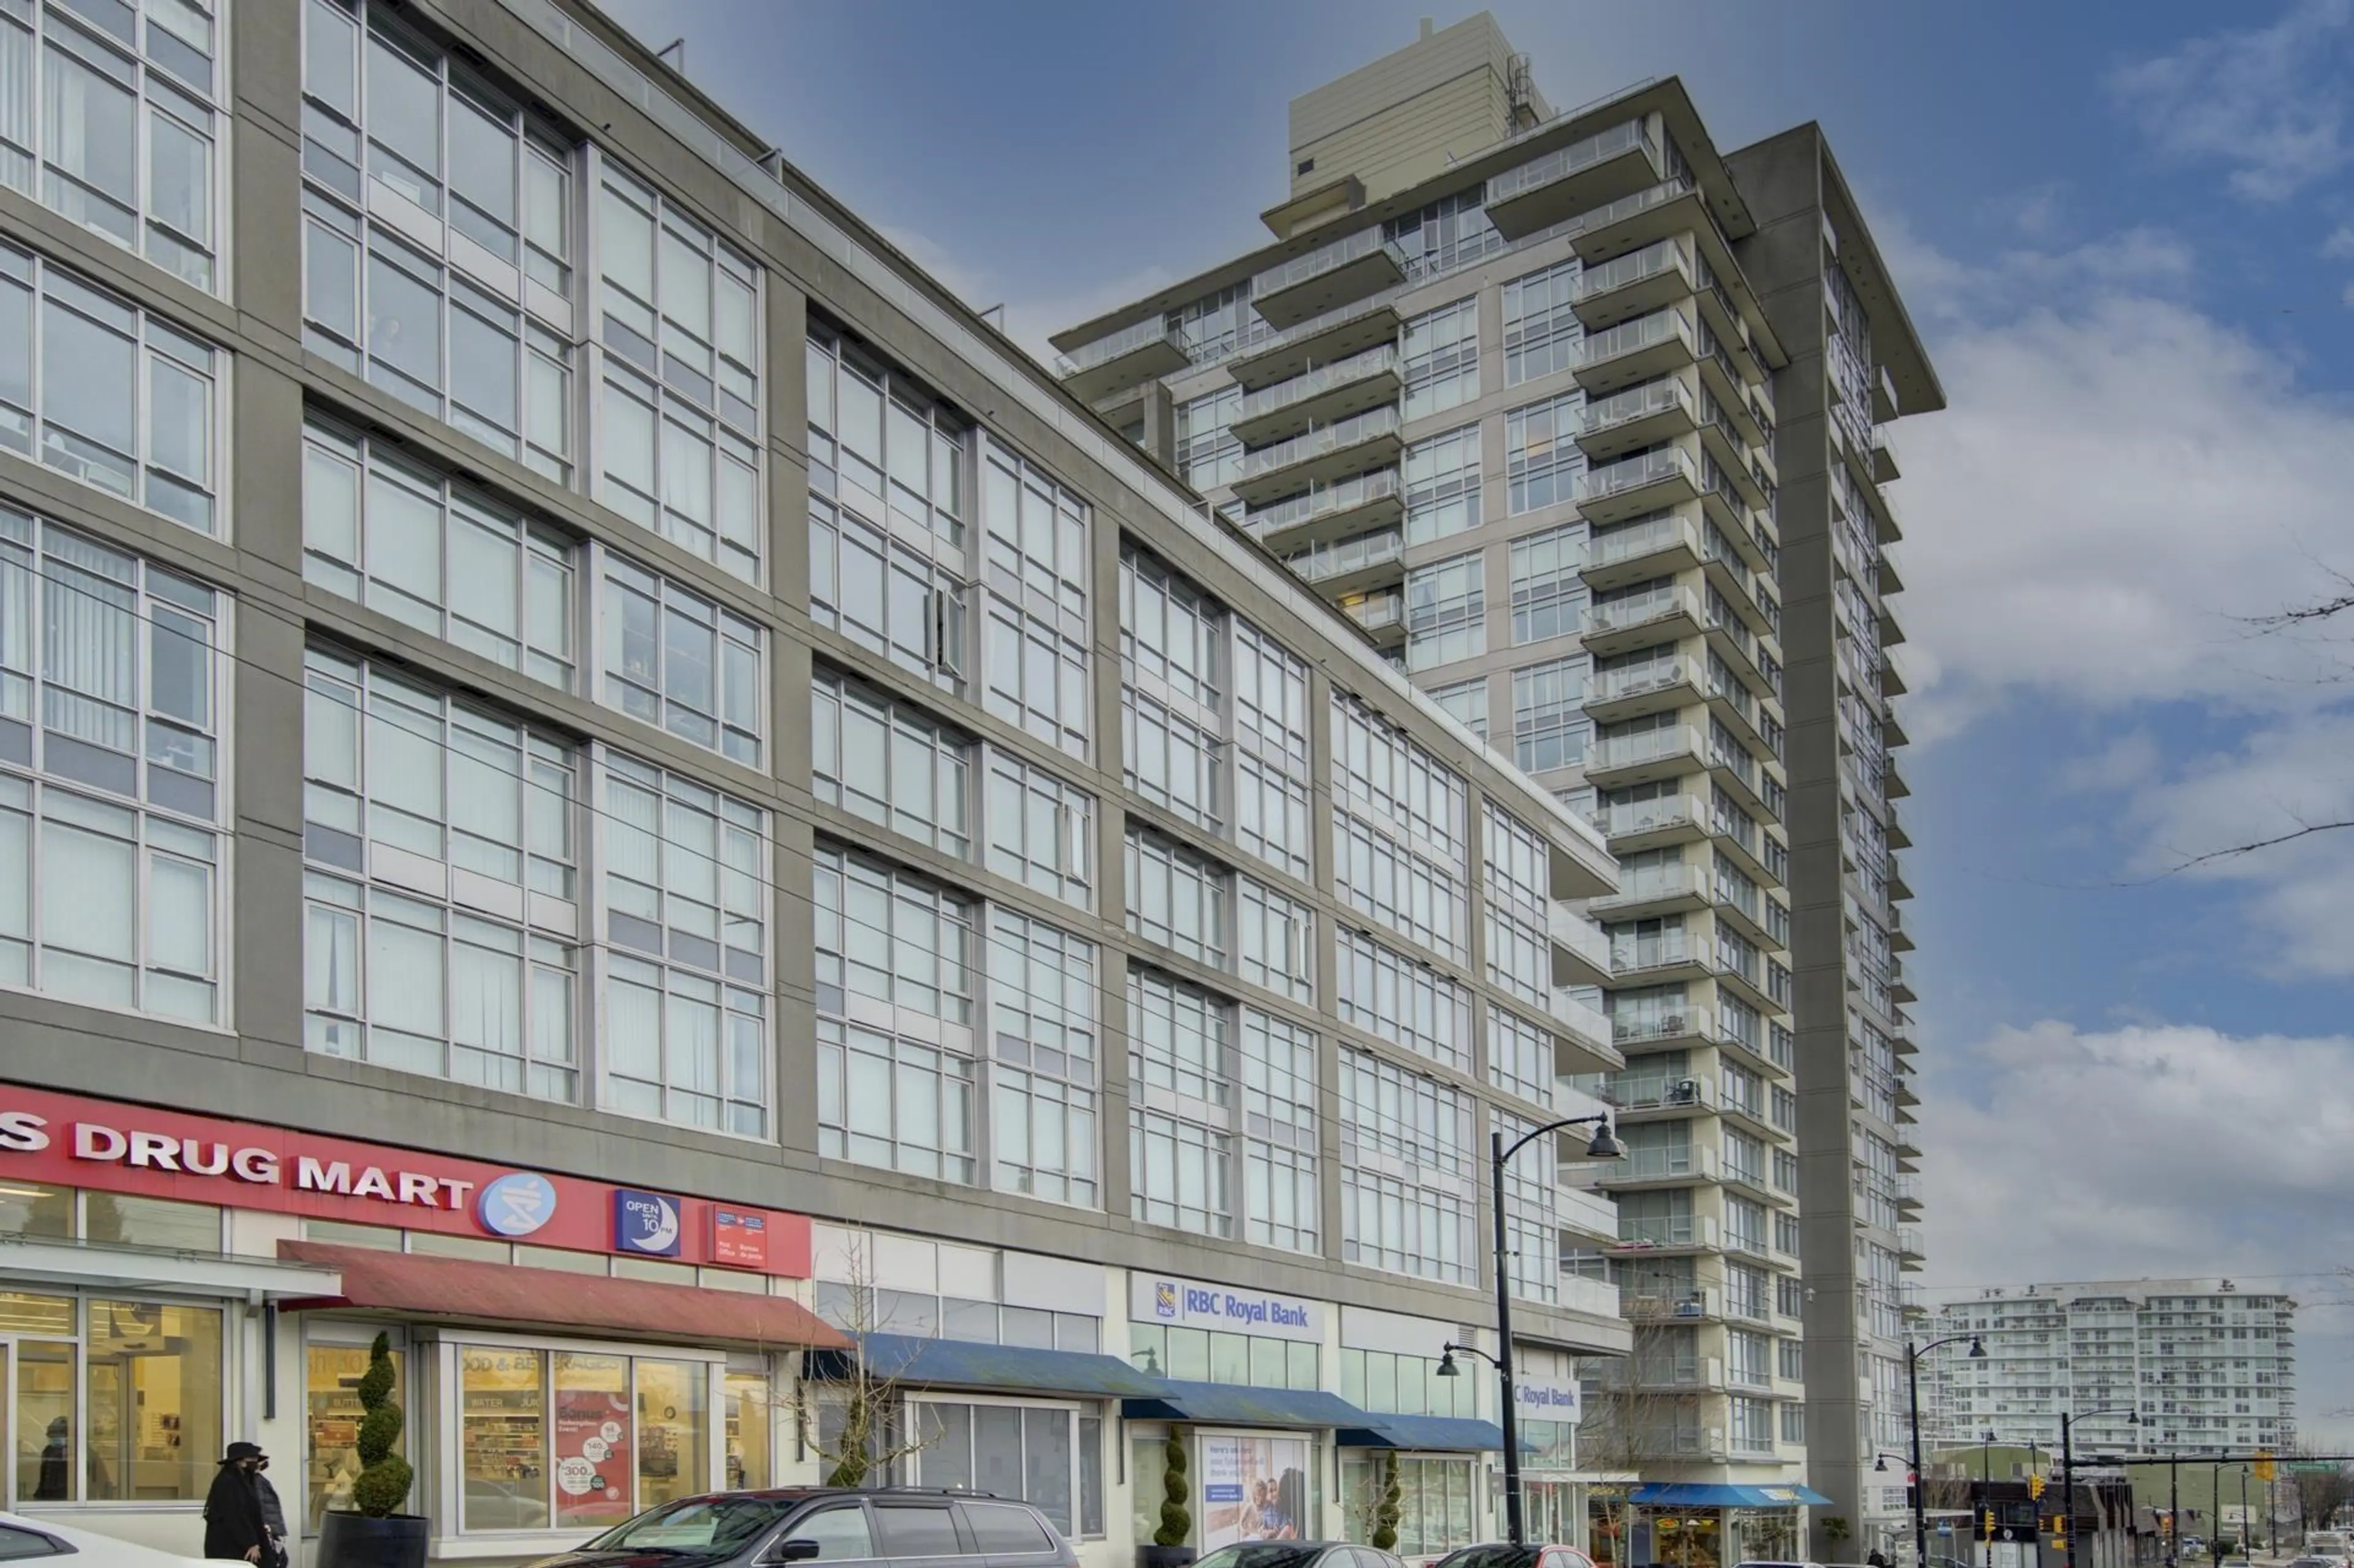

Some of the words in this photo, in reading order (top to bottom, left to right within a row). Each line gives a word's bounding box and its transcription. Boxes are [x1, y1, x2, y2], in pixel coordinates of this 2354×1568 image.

[74, 1122, 280, 1184] DRUG
[297, 1156, 474, 1209] MART
[626, 1200, 659, 1214] OPEN
[642, 1218, 660, 1233] 10
[1158, 1306, 1175, 1316] RBC
[1187, 1288, 1221, 1315] RBC
[1225, 1295, 1268, 1325] Royal
[1271, 1301, 1308, 1328] Bank
[470, 1398, 503, 1408] WATER
[1523, 1385, 1550, 1409] Royal
[1552, 1388, 1575, 1406] Bank
